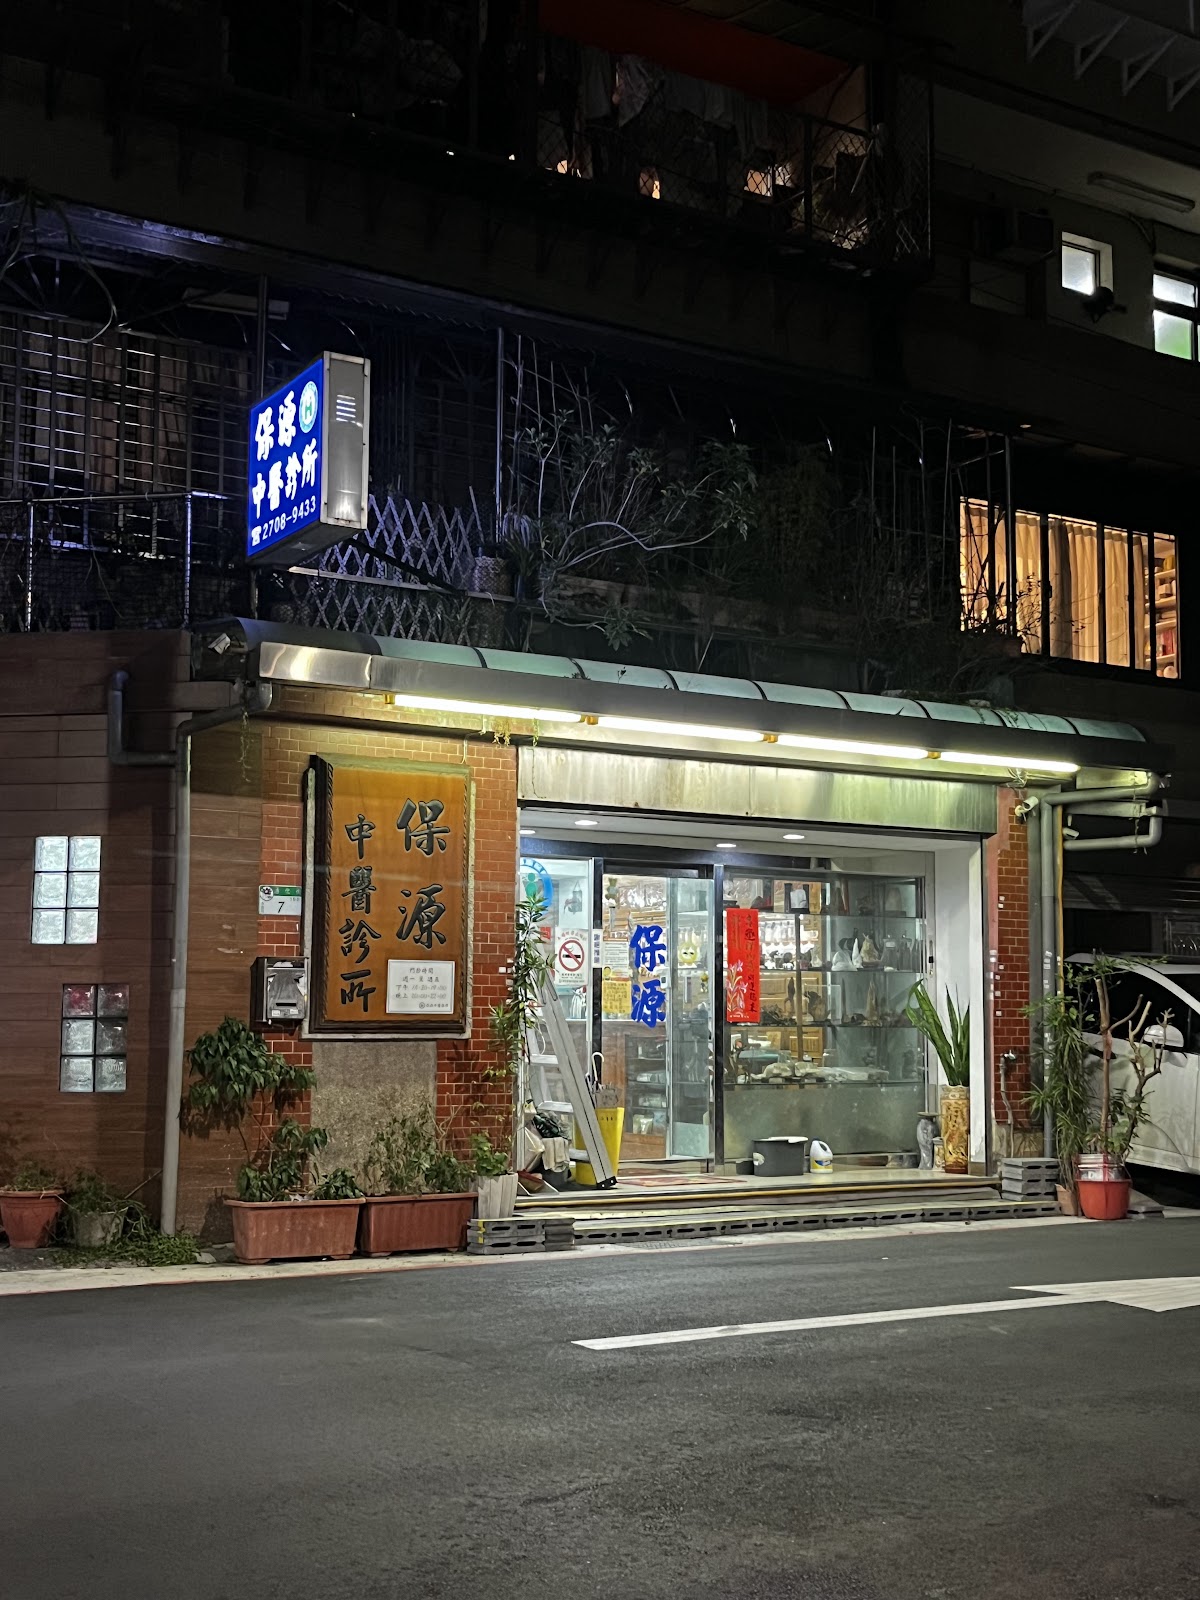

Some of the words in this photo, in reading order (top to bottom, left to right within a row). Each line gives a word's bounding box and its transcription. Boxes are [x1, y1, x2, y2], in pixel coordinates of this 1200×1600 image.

[255, 390, 296, 461] 保源
[252, 438, 318, 519] 中醫診所
[262, 495, 316, 540] 2708-9433
[278, 901, 285, 913] 7
[339, 813, 381, 1012] 中醫診所
[395, 797, 450, 950] 保源
[629, 924, 667, 1028] 保源
